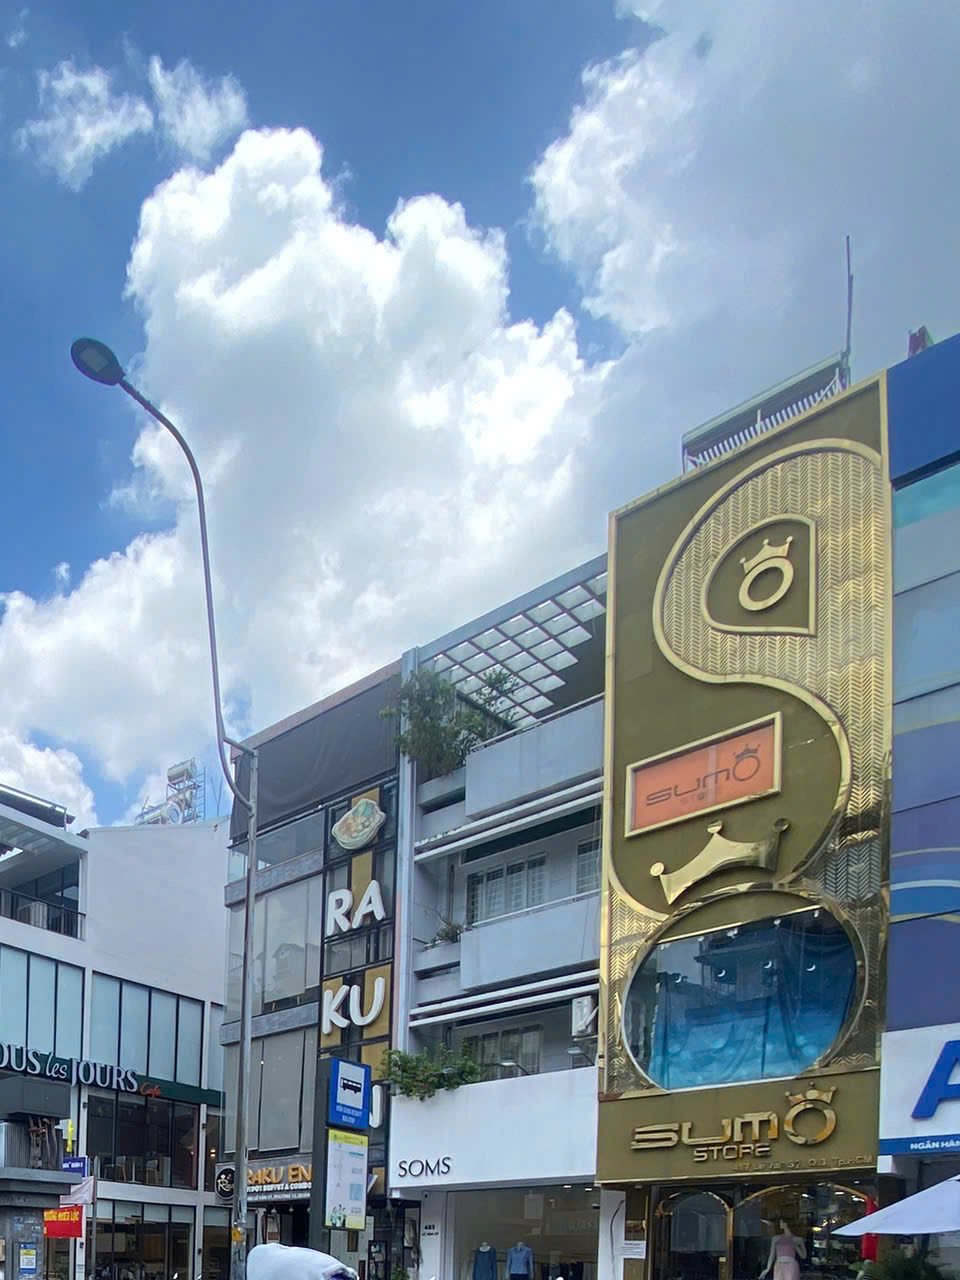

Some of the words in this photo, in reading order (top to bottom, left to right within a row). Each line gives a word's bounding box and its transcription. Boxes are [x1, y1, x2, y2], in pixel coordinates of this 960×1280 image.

[326, 879, 386, 938] RA
[322, 977, 386, 1035] KU
[44, 1050, 68, 1080] les
[70, 1060, 139, 1094] JOURS
[692, 1143, 771, 1163] STORE
[910, 1140, 940, 1150] NGÂN
[398, 1156, 452, 1177] SOMS
